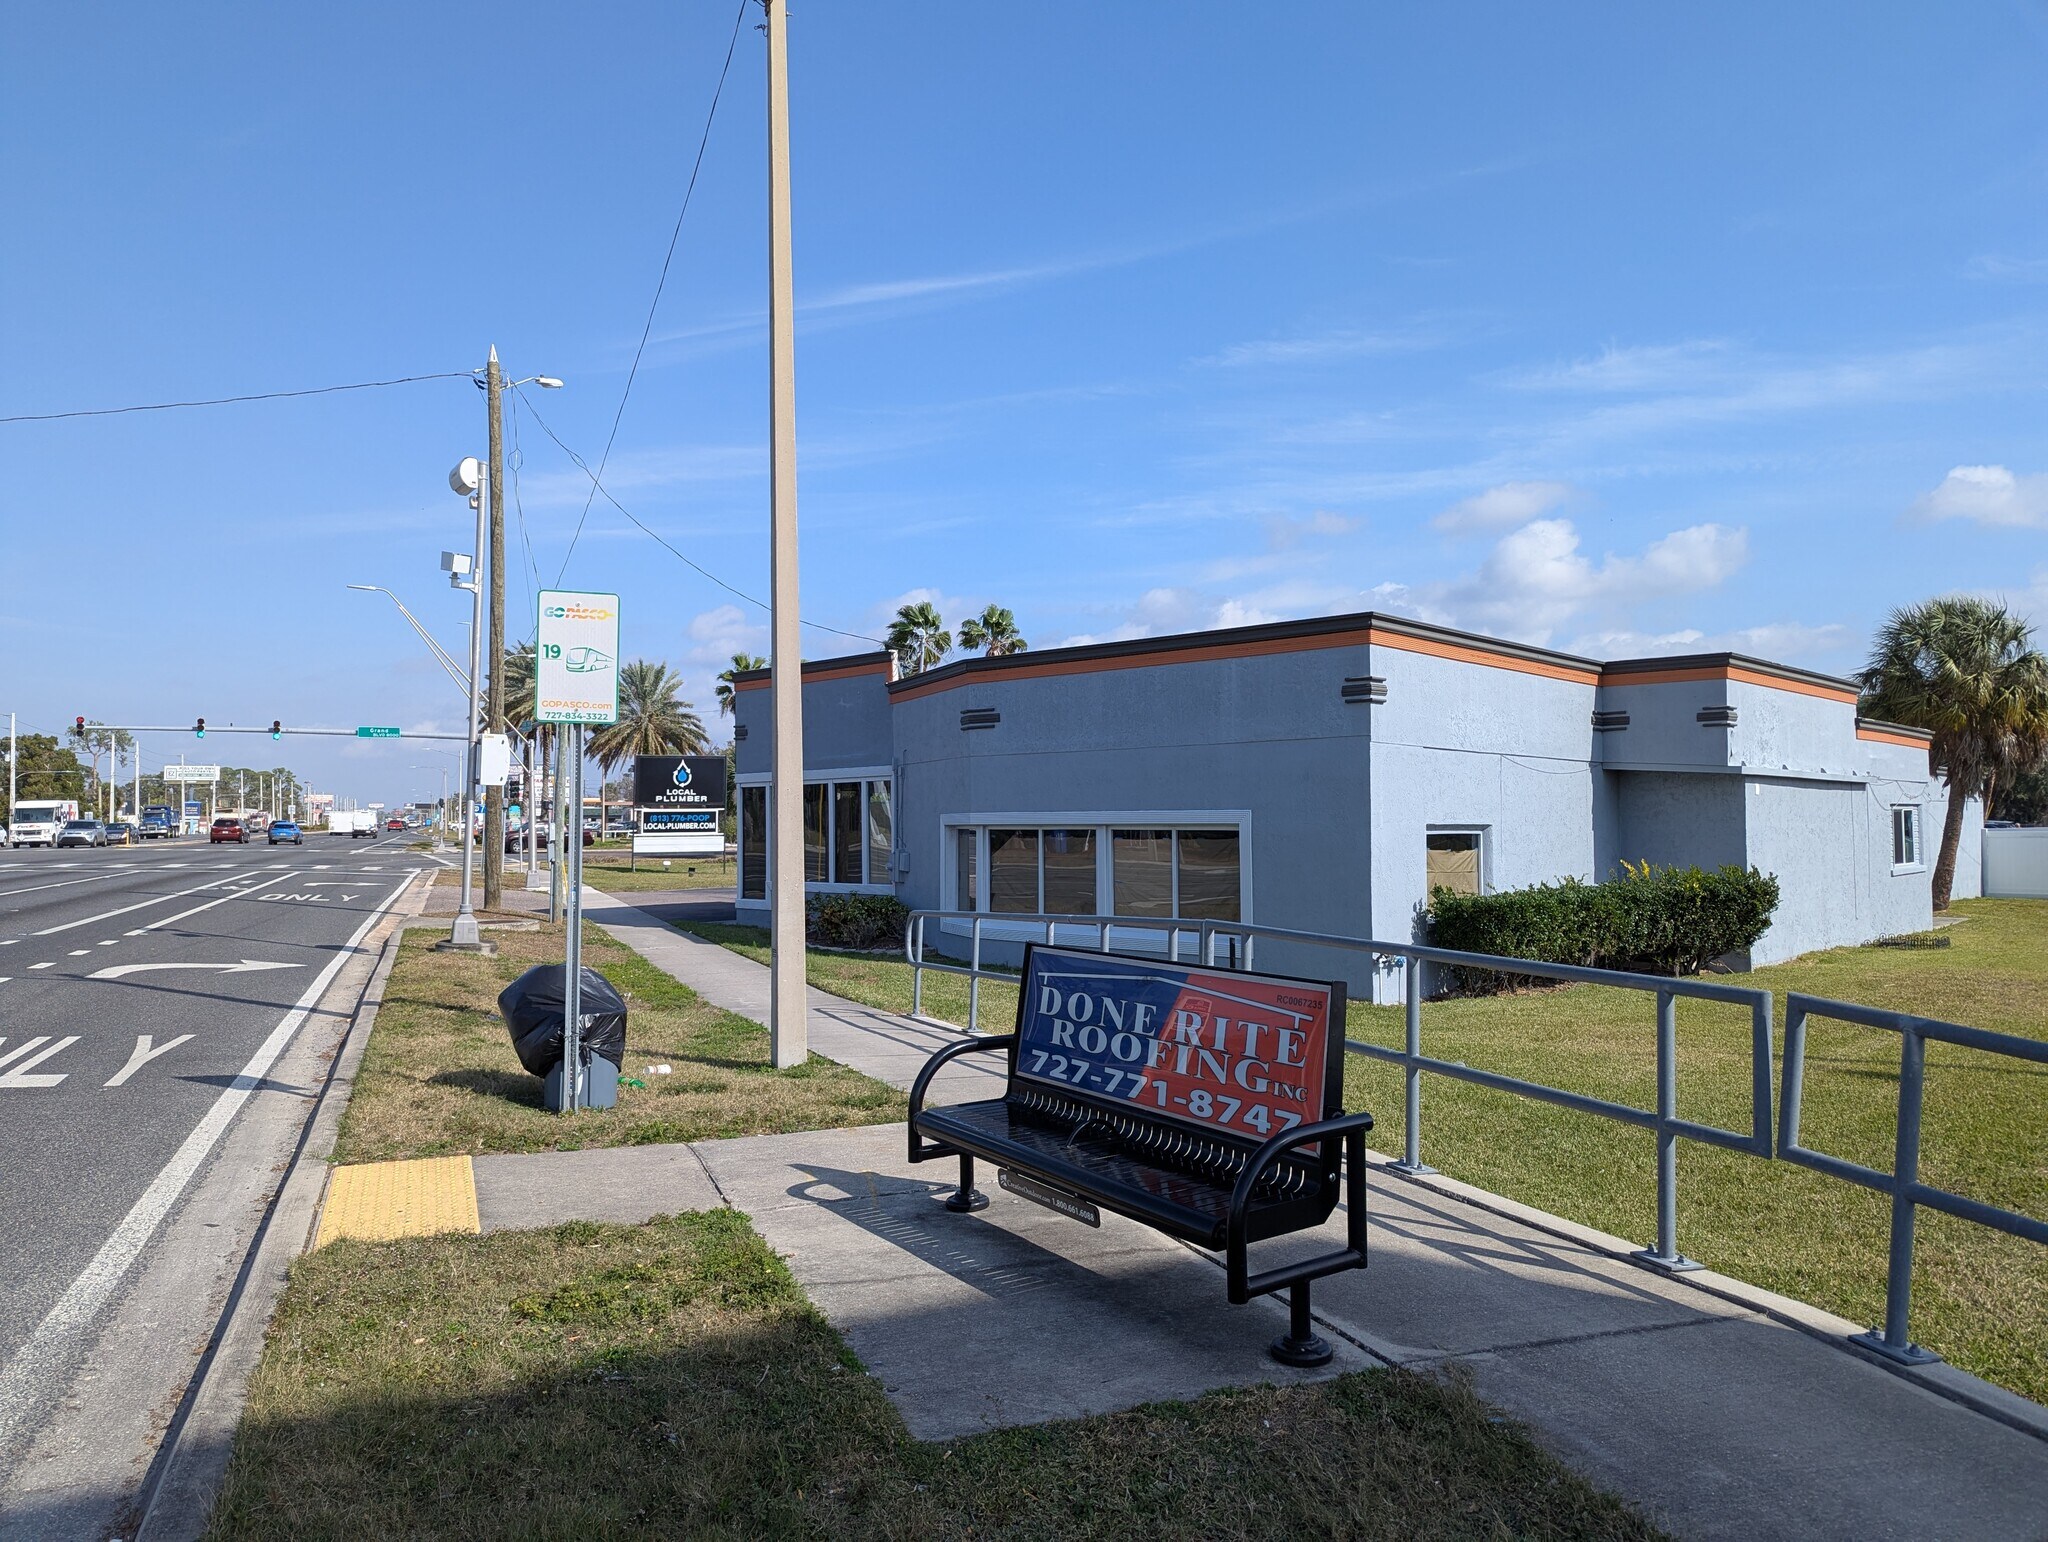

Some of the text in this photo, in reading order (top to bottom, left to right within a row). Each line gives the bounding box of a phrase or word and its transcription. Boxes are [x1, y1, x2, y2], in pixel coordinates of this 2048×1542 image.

[543, 644, 562, 659] 19
[541, 700, 612, 710] GOPASCO.com
[545, 711, 608, 720] 727-834-3322
[649, 814, 710, 822] (813) 776-POOP
[644, 822, 716, 830] LOCAL-PLUMBER.COM
[257, 893, 361, 902] ONLY
[1276, 994, 1323, 1010] RC0067235
[1038, 985, 1307, 1069] DONE RITE
[1050, 1018, 1308, 1102] ROOFING INC
[1030, 1048, 1302, 1135] 727-771-8747
[1007, 1180, 1051, 1204] CreativeOutdoor.com
